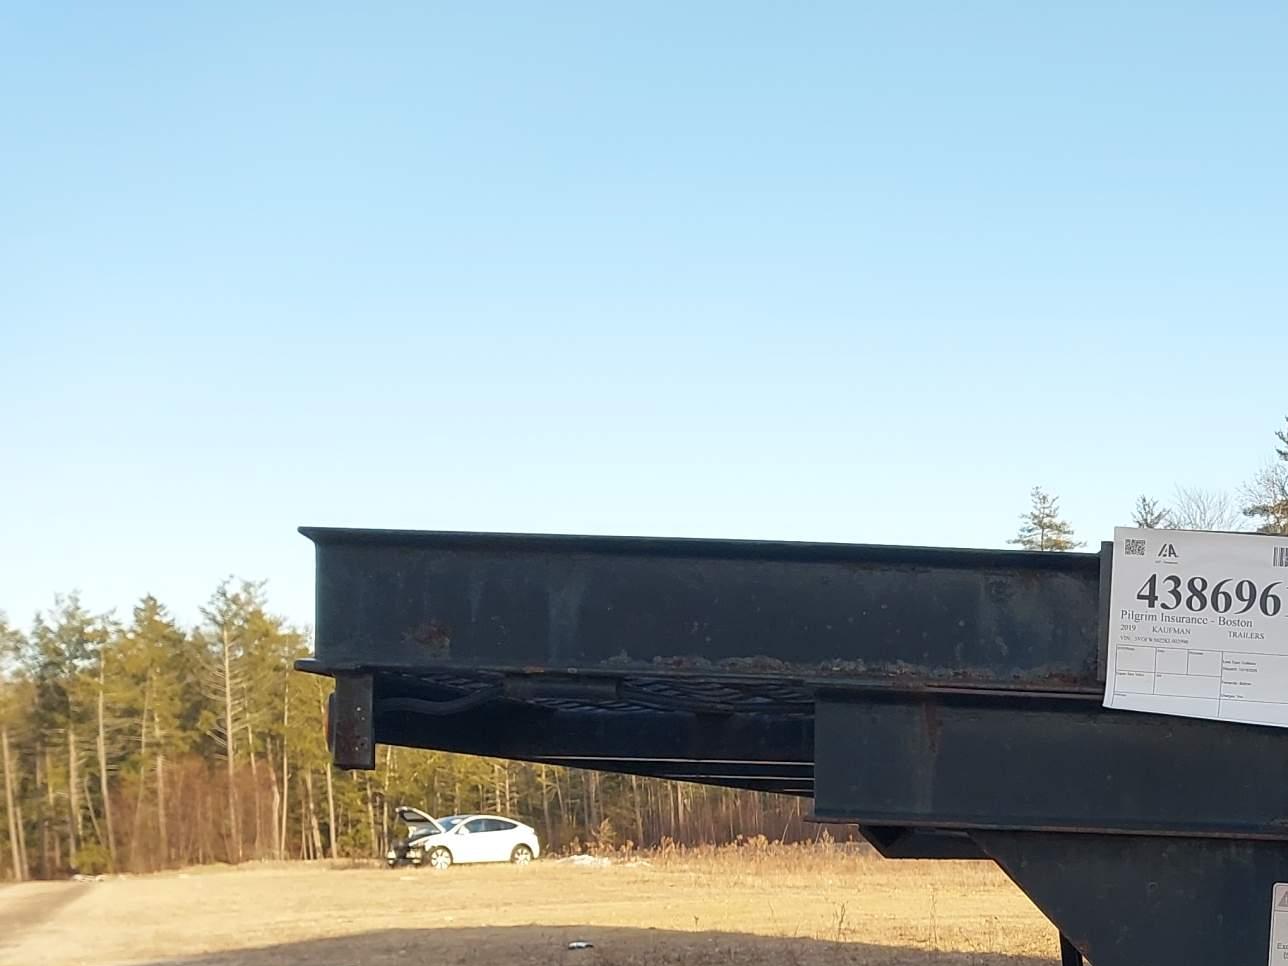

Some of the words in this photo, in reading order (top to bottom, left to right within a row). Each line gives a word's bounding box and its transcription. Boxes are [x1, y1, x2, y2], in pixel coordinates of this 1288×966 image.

[1121, 610, 1157, 623] Pilgrim
[1161, 612, 1208, 625] Insurance
[1218, 616, 1253, 628] Boston
[1120, 624, 1136, 632] 2019
[1152, 626, 1191, 635] KAUFMAN
[1228, 631, 1265, 640] TRAILERS
